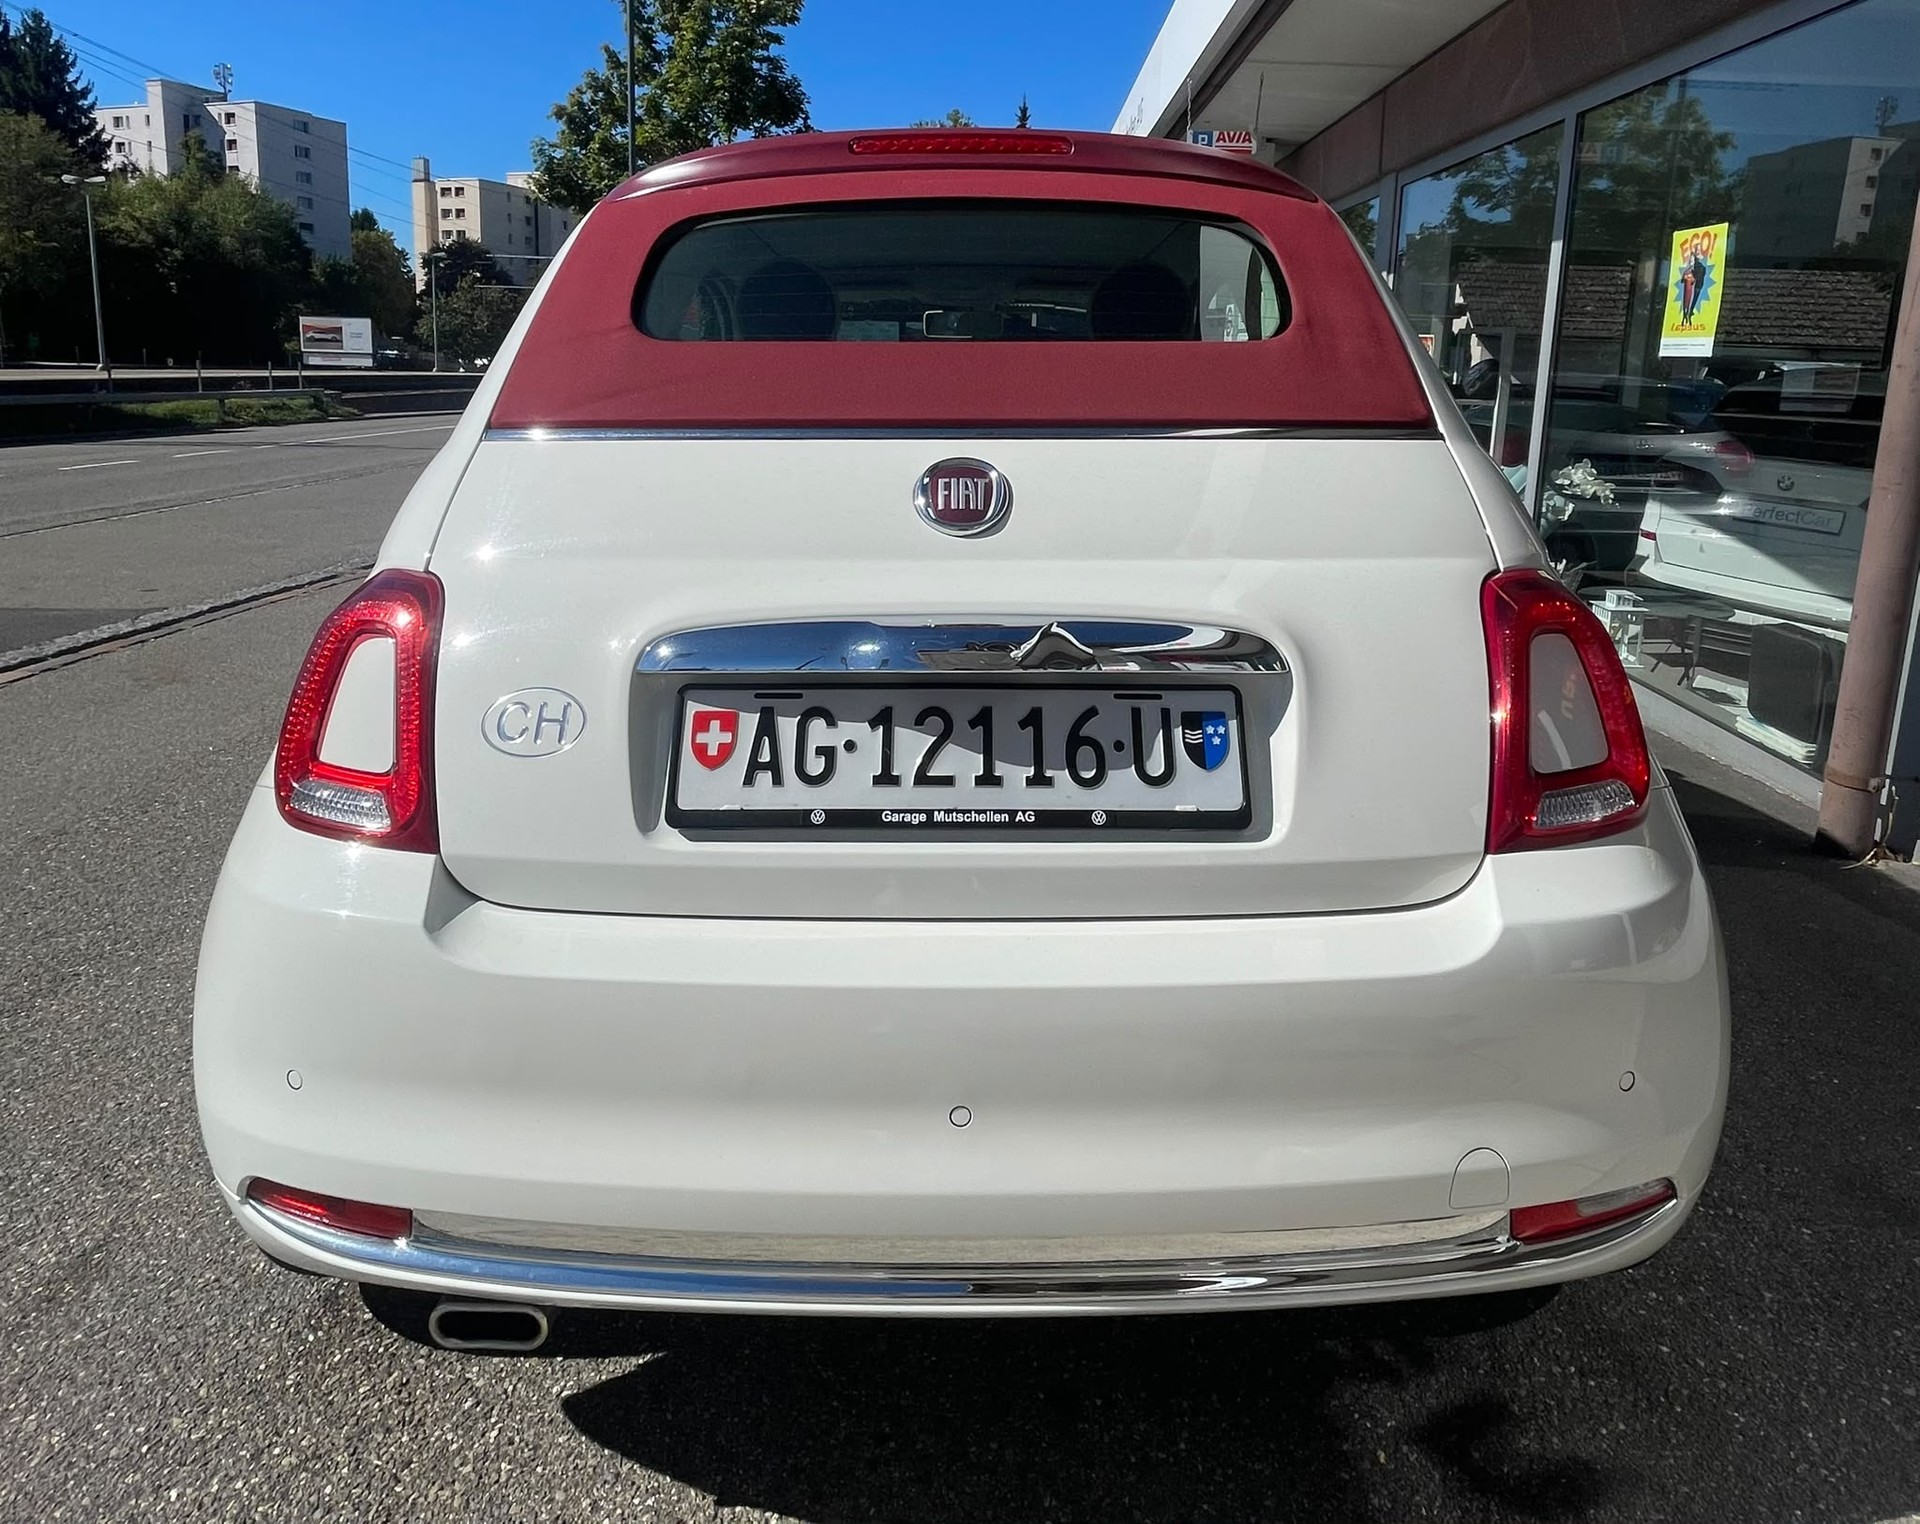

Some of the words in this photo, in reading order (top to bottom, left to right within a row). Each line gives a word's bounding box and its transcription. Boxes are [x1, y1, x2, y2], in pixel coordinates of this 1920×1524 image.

[1215, 131, 1253, 144] AVIA
[937, 478, 989, 510] FIAT
[497, 701, 572, 745] CH
[881, 810, 927, 825] Garage
[933, 810, 1009, 822] Mutschellen
[1015, 810, 1035, 822] AG
